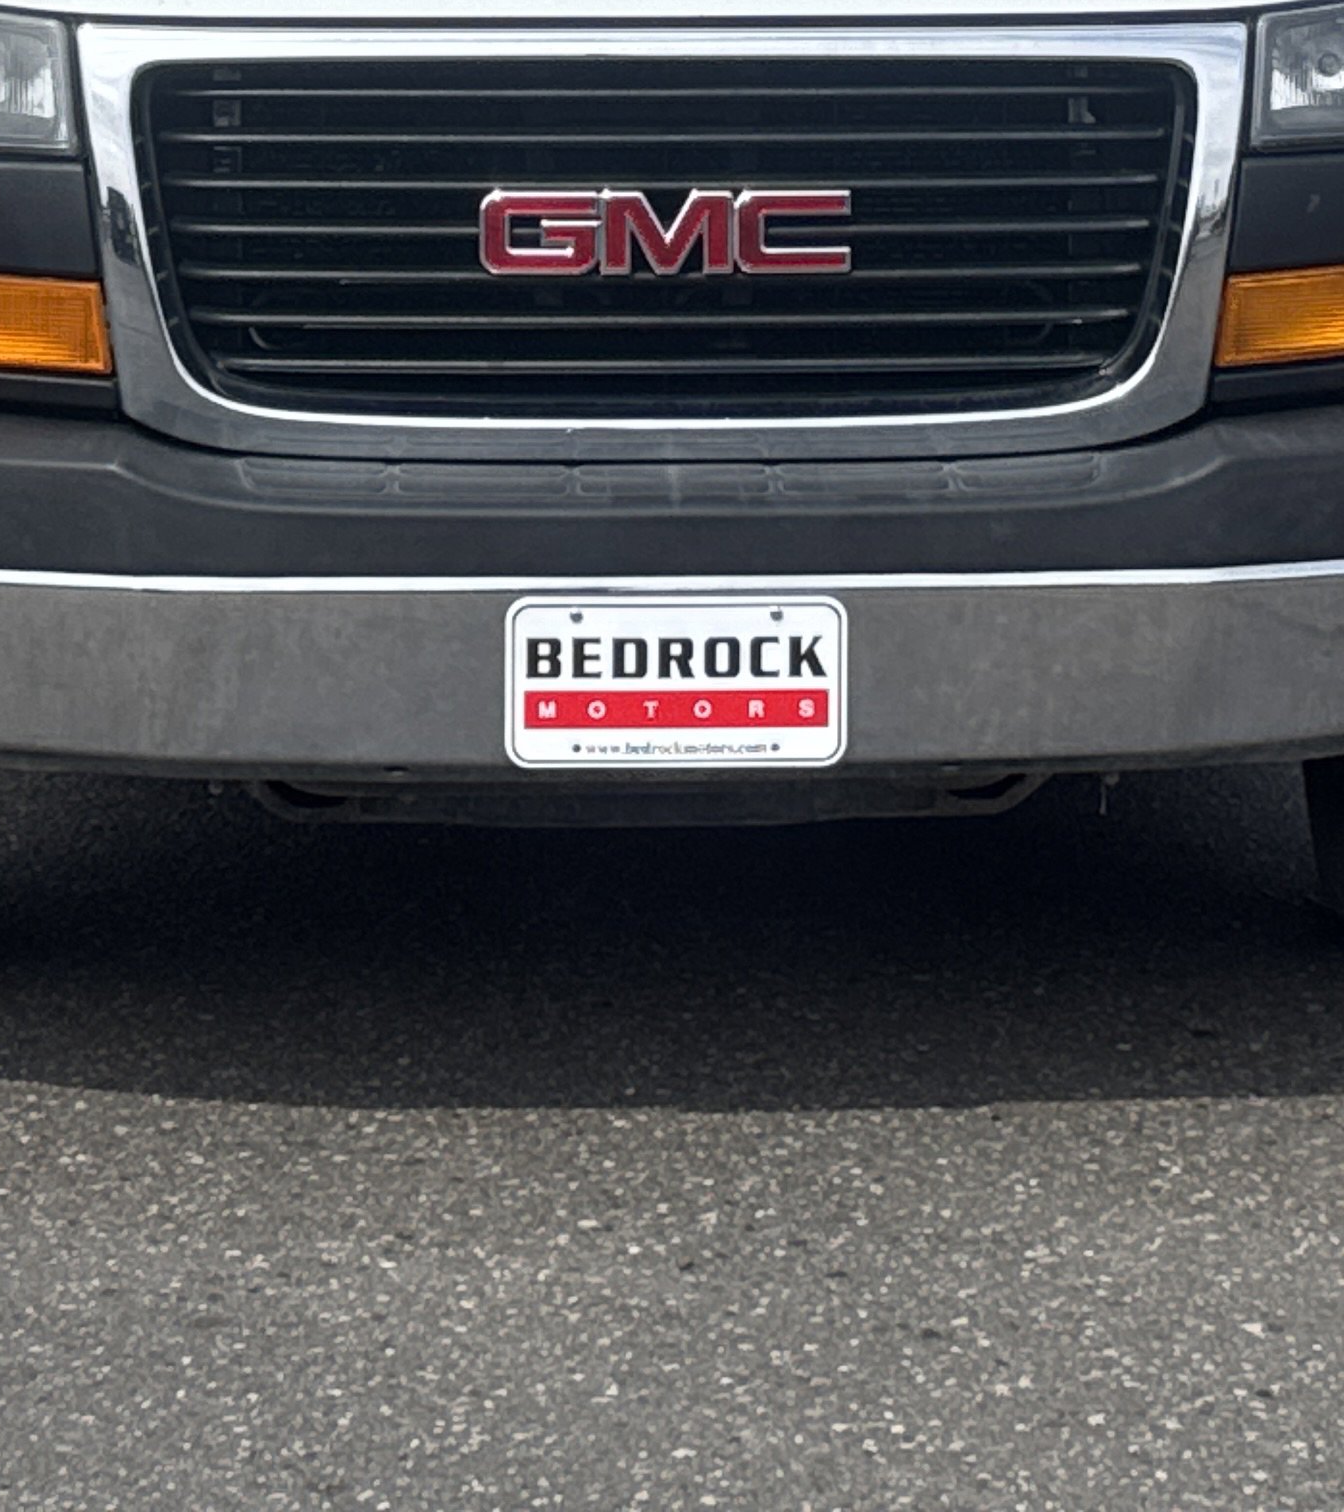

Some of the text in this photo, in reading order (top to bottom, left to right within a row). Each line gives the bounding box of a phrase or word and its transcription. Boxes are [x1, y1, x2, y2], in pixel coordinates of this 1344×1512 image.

[480, 189, 852, 275] GMC
[525, 635, 827, 679] BEDROCK
[538, 699, 815, 719] MOTORS
